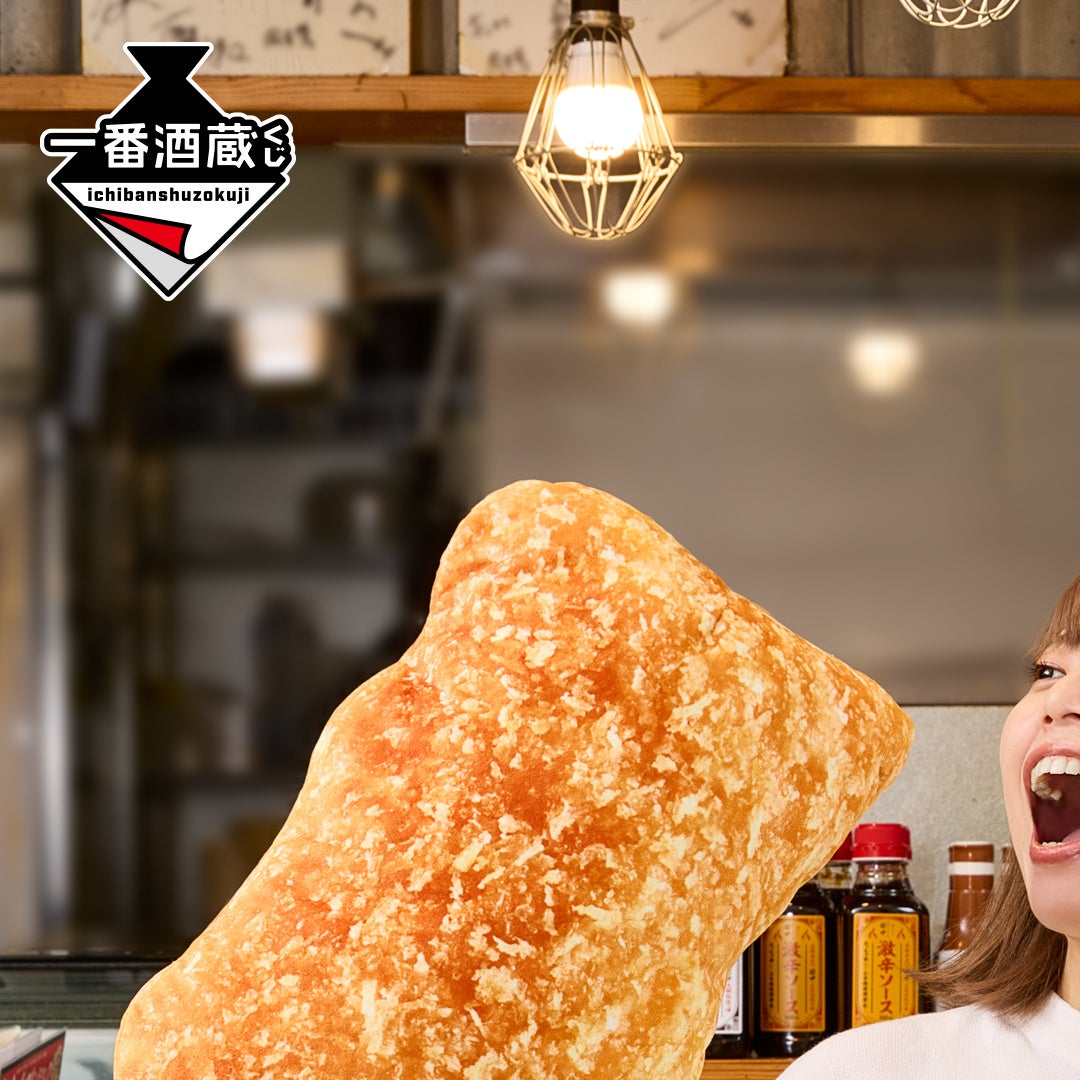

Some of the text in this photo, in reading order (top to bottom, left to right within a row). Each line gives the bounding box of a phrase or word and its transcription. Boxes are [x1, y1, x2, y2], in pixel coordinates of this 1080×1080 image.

[877, 939, 897, 1014] 激辛ソース
